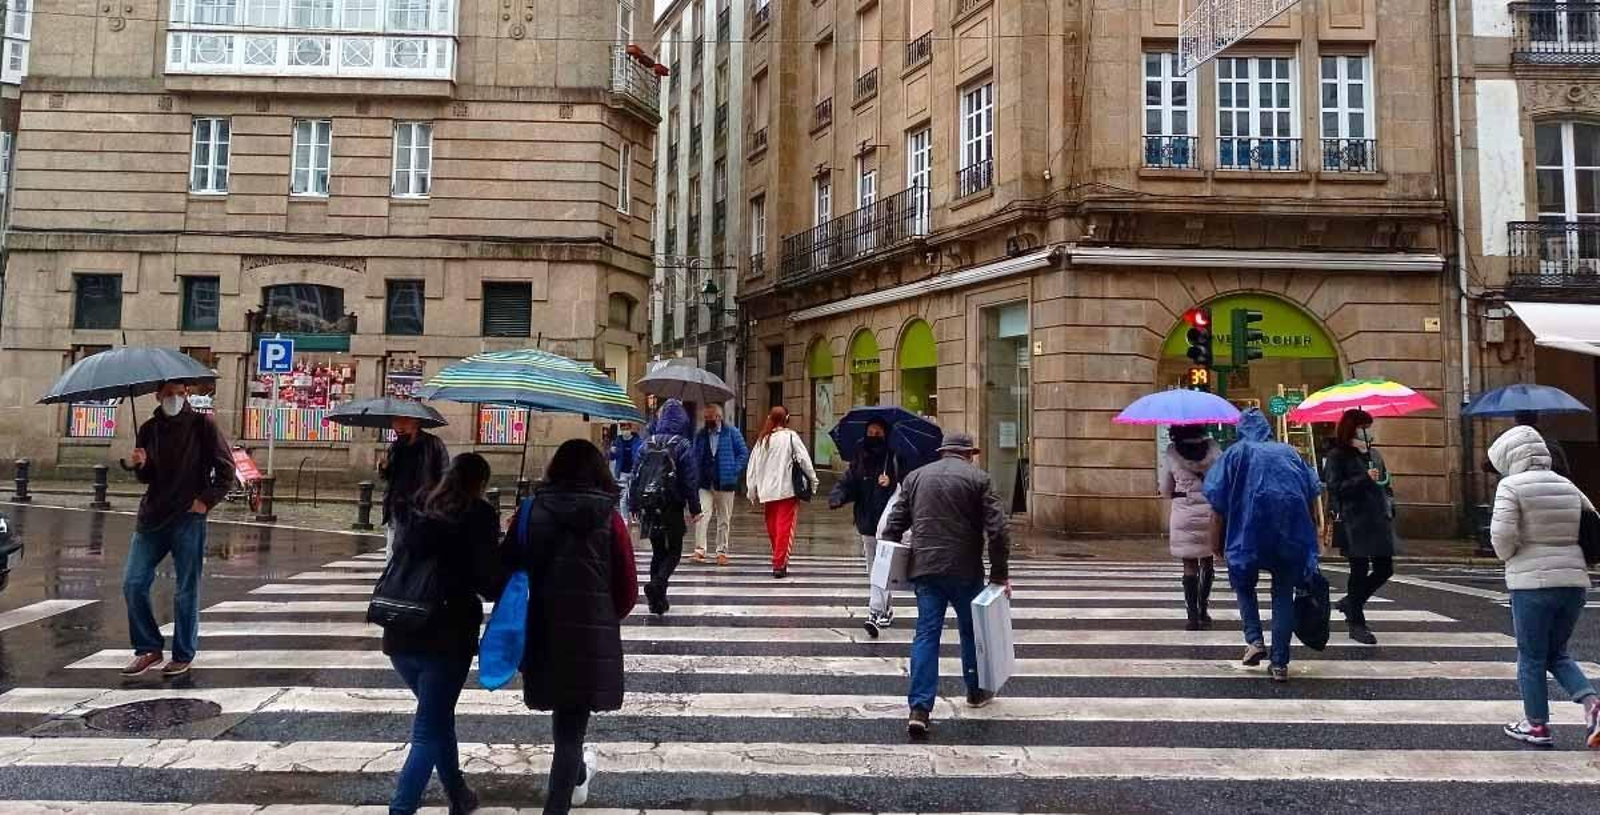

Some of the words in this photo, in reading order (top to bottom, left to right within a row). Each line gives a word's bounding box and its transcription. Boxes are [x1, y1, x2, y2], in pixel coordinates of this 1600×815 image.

[1256, 335, 1312, 346] OCHER
[266, 343, 286, 369] P
[1191, 369, 1207, 385] 39
